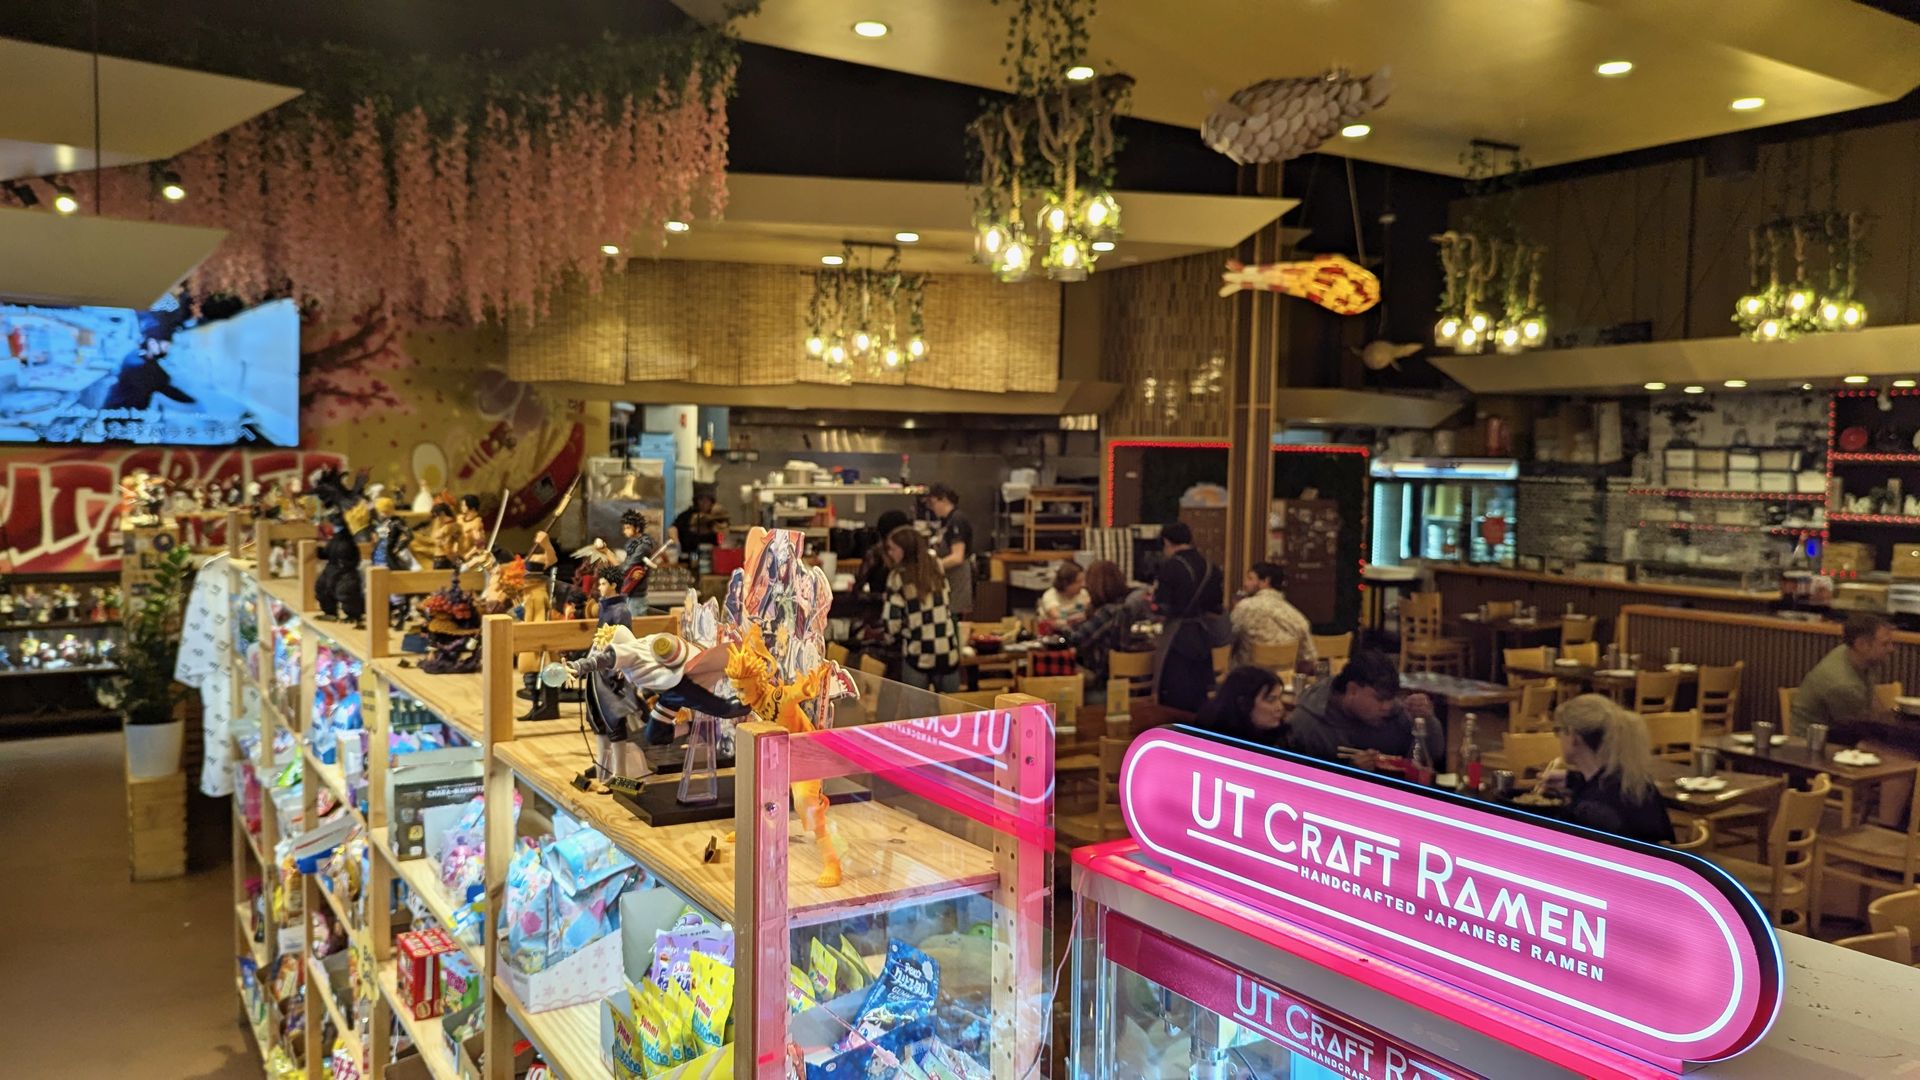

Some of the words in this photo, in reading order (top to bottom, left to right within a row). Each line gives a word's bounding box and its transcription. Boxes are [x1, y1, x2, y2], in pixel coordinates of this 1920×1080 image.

[1191, 771, 1256, 839] UT
[1264, 802, 1400, 887] CRAFT
[1416, 842, 1607, 959] RAMEN
[1300, 865, 1416, 915] HANDCRAFTED
[1424, 909, 1521, 953] JAPANESE
[1531, 944, 1604, 982] RAMEN
[1235, 974, 1280, 1025] UT
[1285, 1004, 1375, 1072] CRAFT
